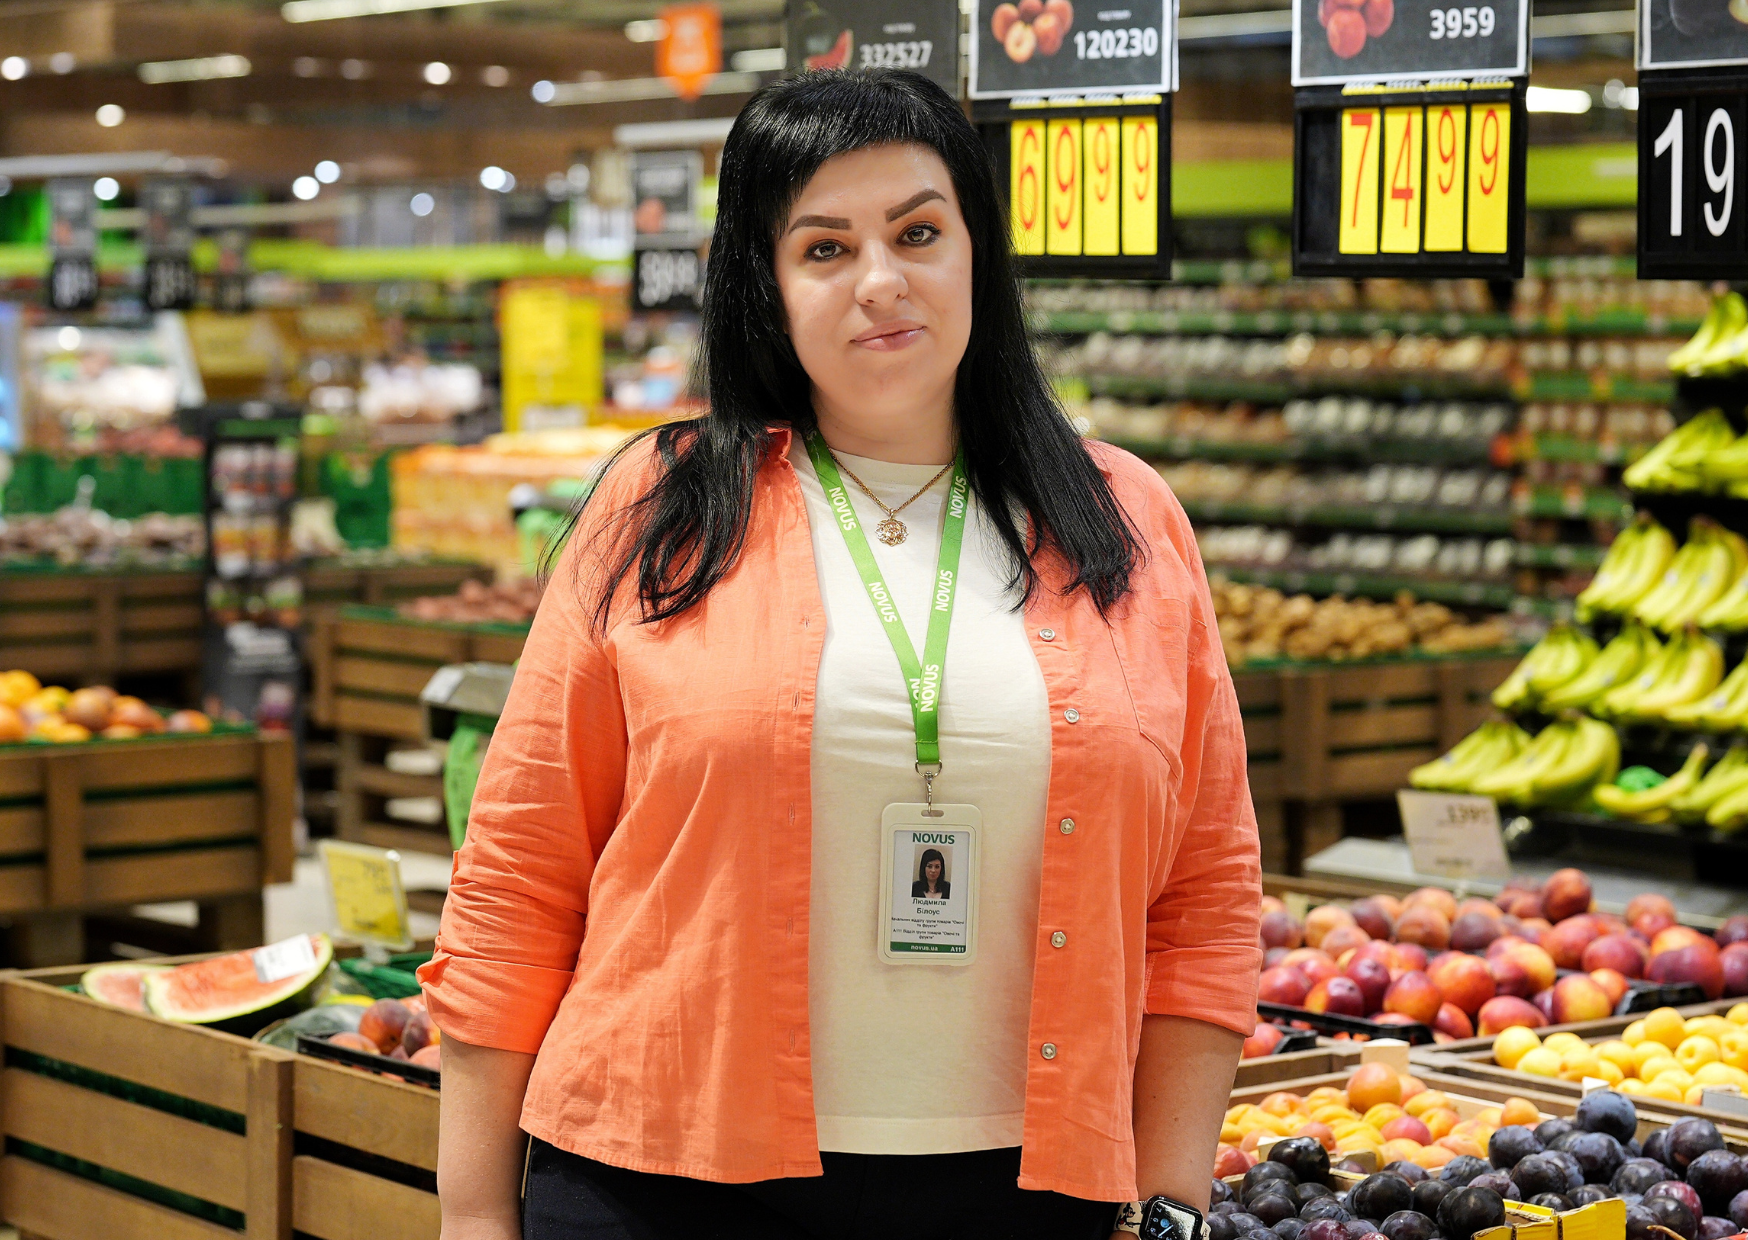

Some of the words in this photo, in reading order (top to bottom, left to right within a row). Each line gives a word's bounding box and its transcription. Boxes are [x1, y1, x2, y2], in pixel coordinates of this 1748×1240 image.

[1429, 6, 1496, 40] 3959
[860, 40, 933, 69] 332527
[1074, 26, 1158, 60] 120230
[1654, 107, 1735, 237] 19
[828, 486, 857, 531] NOVUS
[950, 475, 967, 519] NOVUS
[868, 581, 898, 623] NOVUS
[935, 569, 953, 612] NOVUS
[920, 664, 940, 713] NOVUS
[912, 832, 955, 844] NOVUS
[912, 898, 946, 906] Людмила
[916, 908, 940, 916] Білоус
